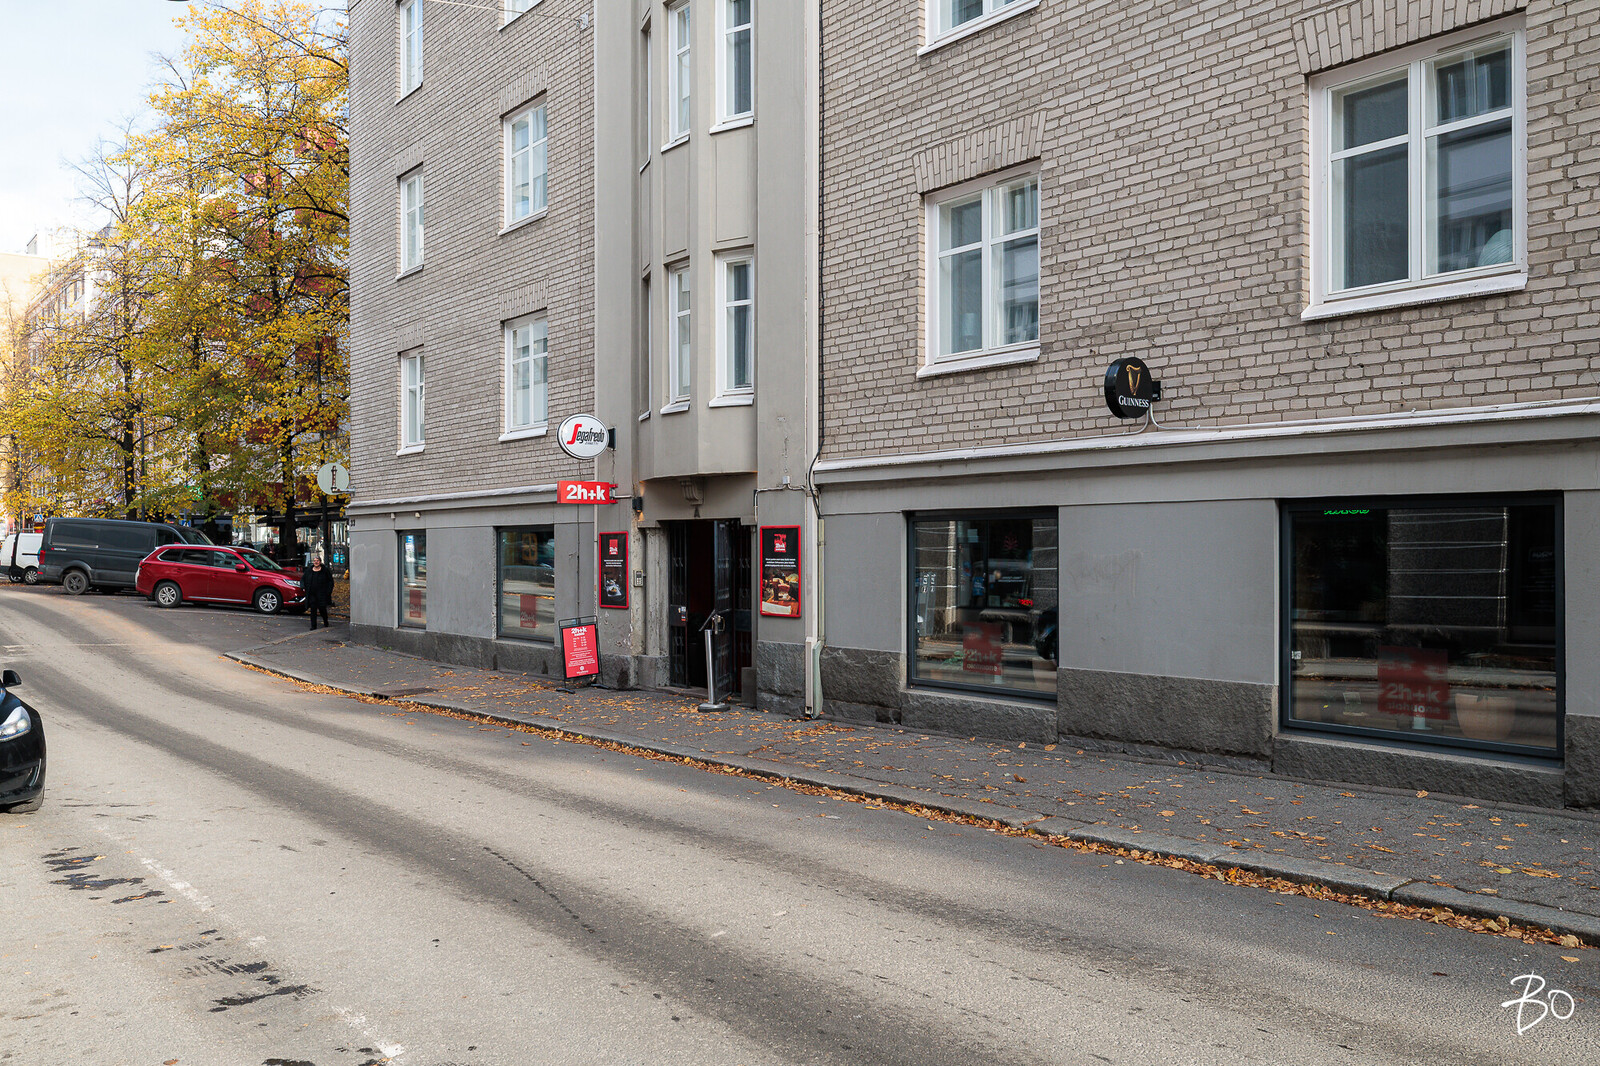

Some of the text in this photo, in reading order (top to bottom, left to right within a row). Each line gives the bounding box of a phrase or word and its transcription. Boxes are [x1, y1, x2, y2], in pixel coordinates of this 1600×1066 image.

[566, 423, 605, 445] Segafredo
[566, 484, 606, 501] 2h+k
[1385, 682, 1441, 703] 2h+k
